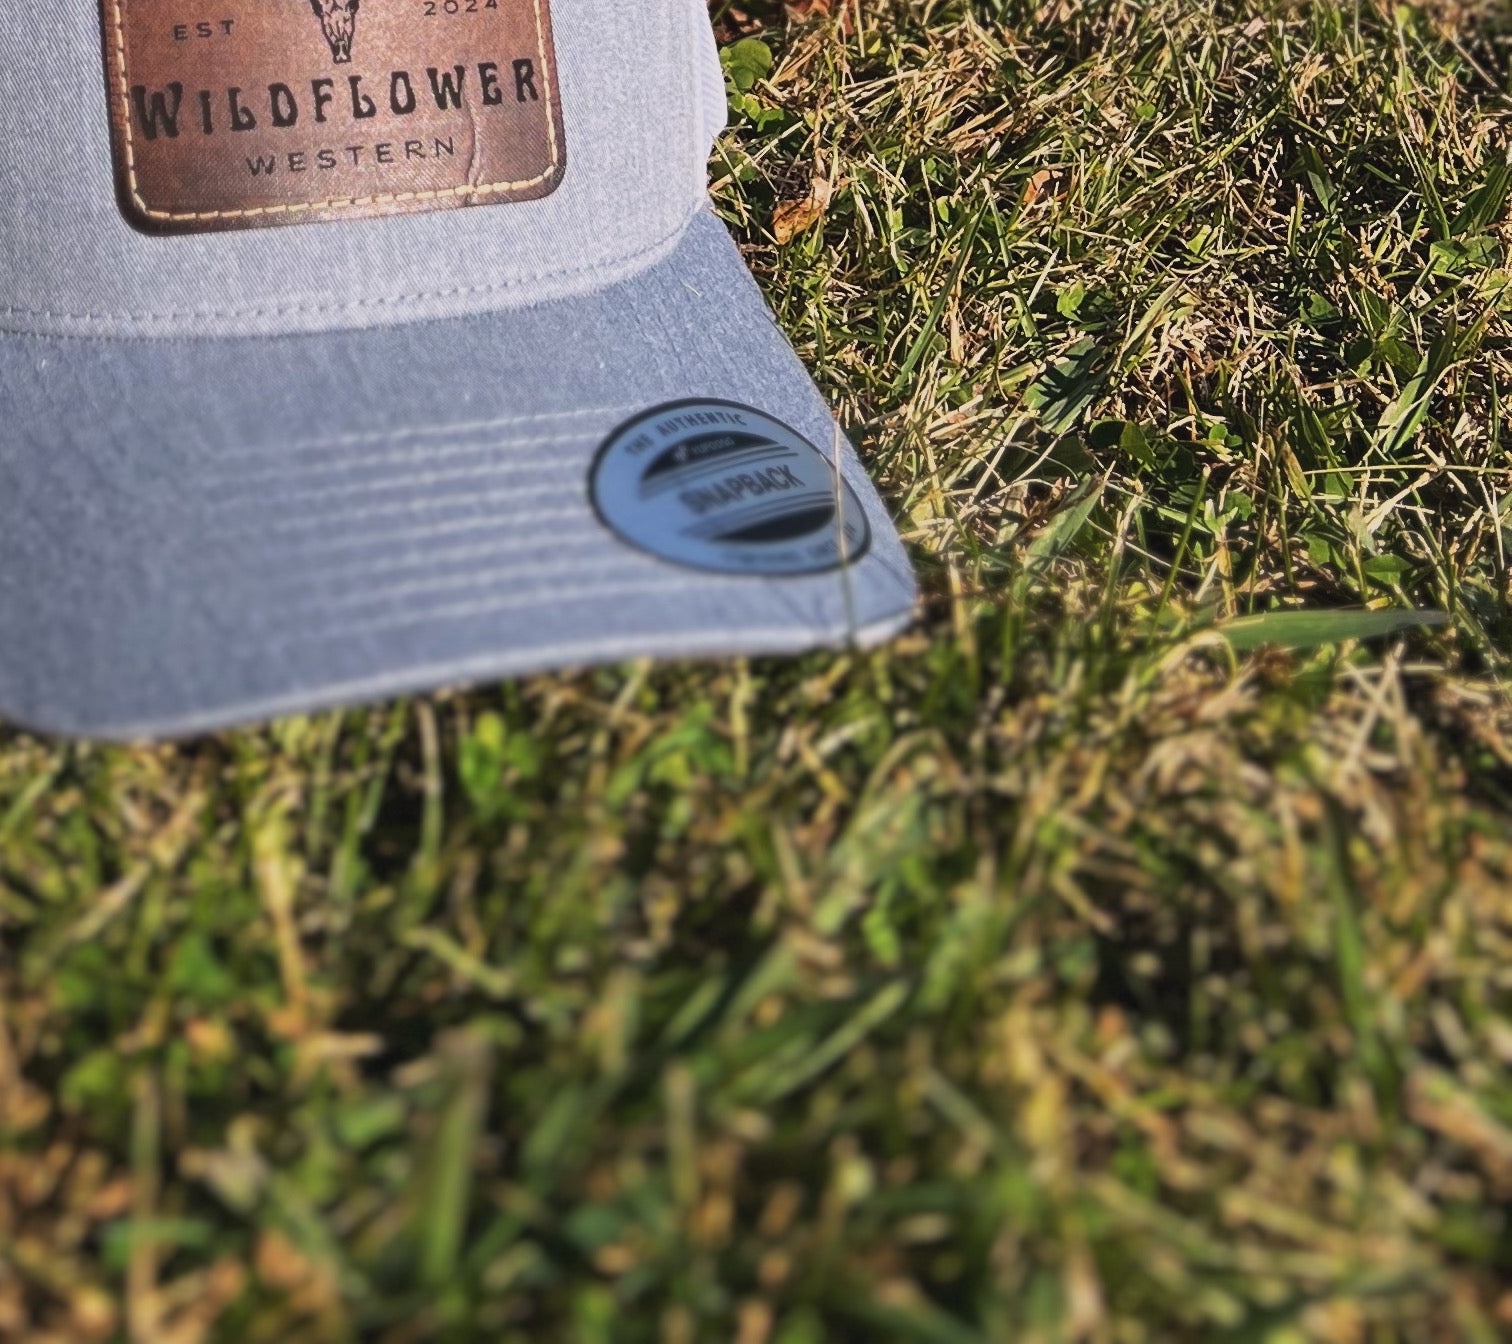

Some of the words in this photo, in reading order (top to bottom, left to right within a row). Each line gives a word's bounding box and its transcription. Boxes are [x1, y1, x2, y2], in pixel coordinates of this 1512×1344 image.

[173, 19, 236, 41] EST
[130, 58, 539, 141] WILDFLOWER
[246, 136, 455, 177] WESTERN
[655, 411, 748, 437] AUTHENTIC
